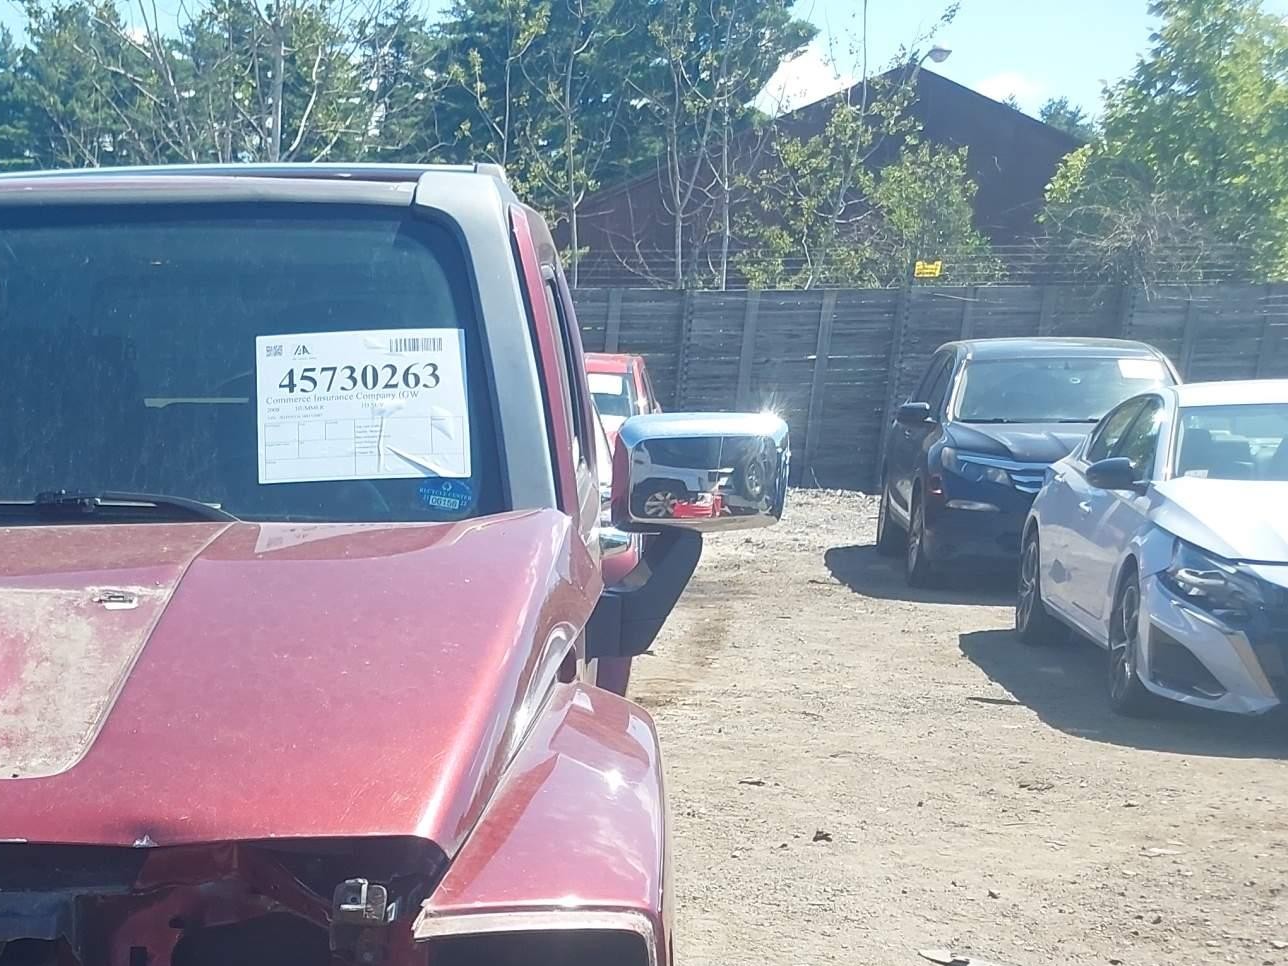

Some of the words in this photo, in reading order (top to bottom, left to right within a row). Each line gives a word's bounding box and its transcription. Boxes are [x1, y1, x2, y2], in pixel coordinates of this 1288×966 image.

[278, 362, 440, 394] 45730263
[266, 396, 311, 405] Commerce
[314, 393, 354, 402] Insurance
[356, 391, 395, 401] Company
